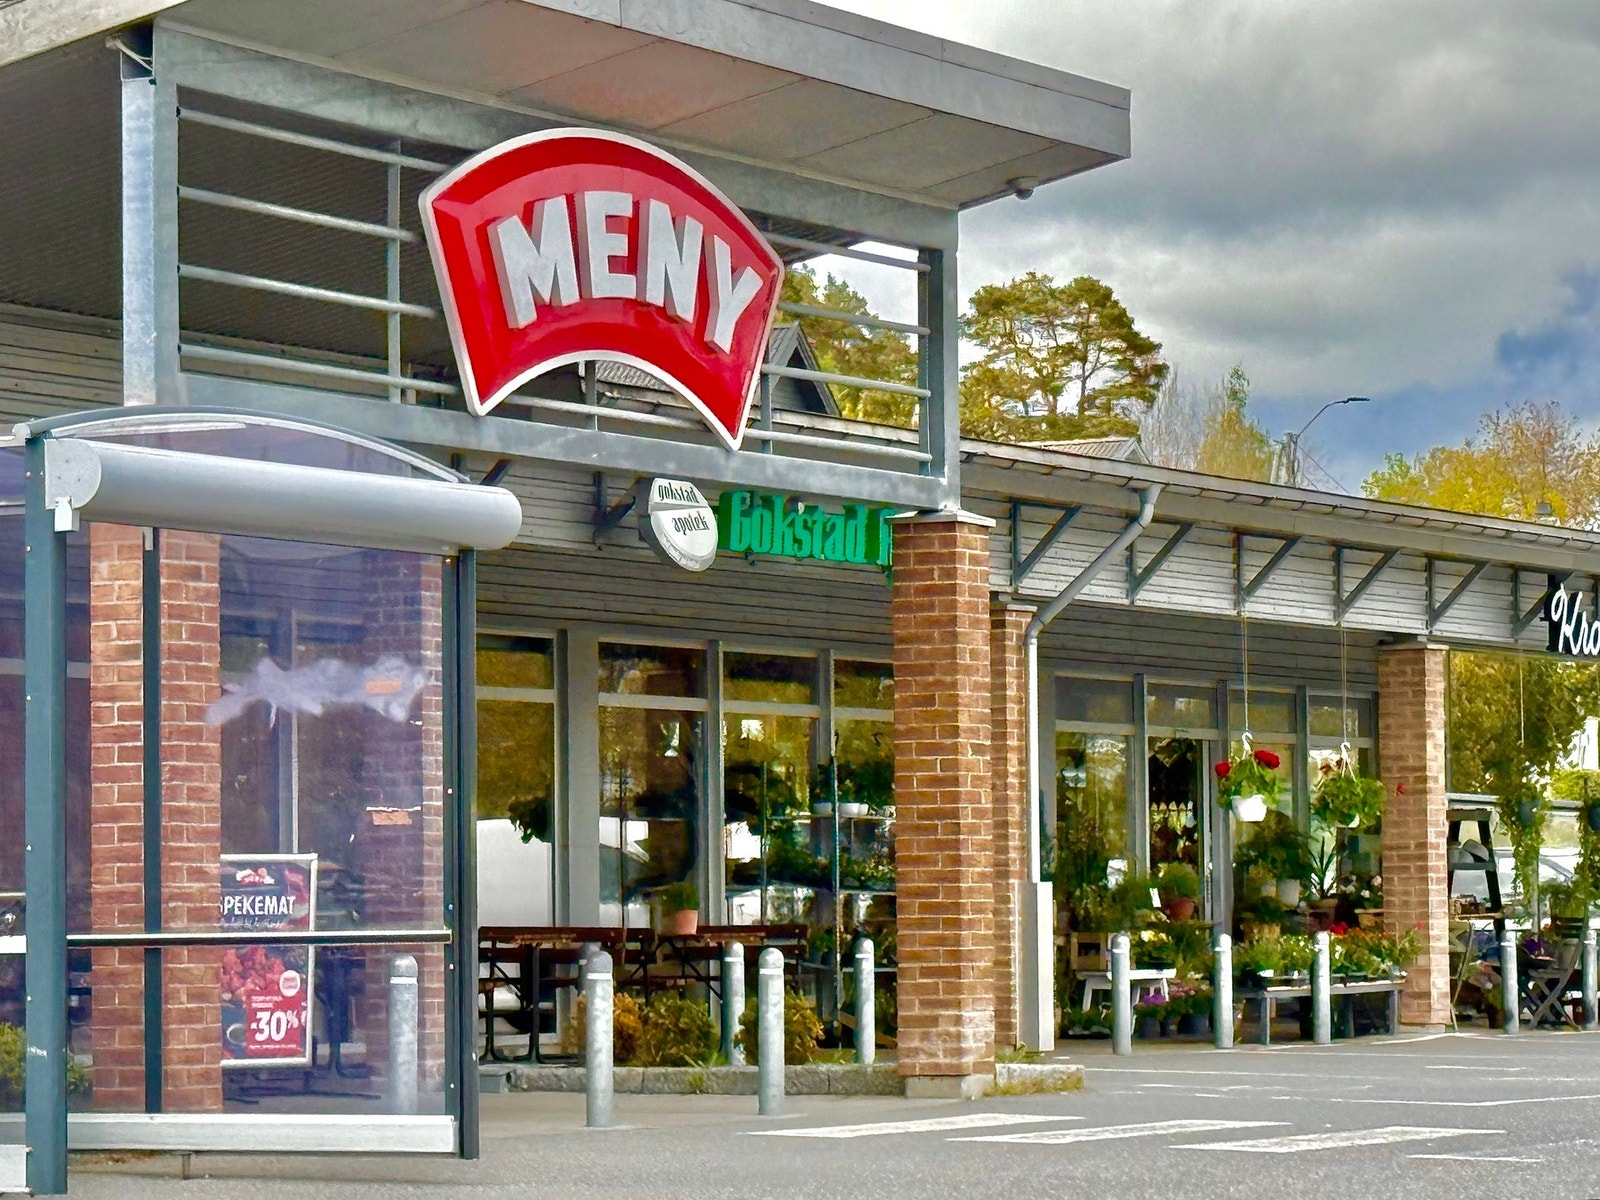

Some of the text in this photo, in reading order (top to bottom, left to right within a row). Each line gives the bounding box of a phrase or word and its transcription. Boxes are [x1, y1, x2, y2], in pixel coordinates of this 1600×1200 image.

[487, 190, 765, 355] MENY
[658, 482, 700, 504] gokstad
[671, 510, 710, 536] apotek
[250, 1010, 299, 1042] -30%
